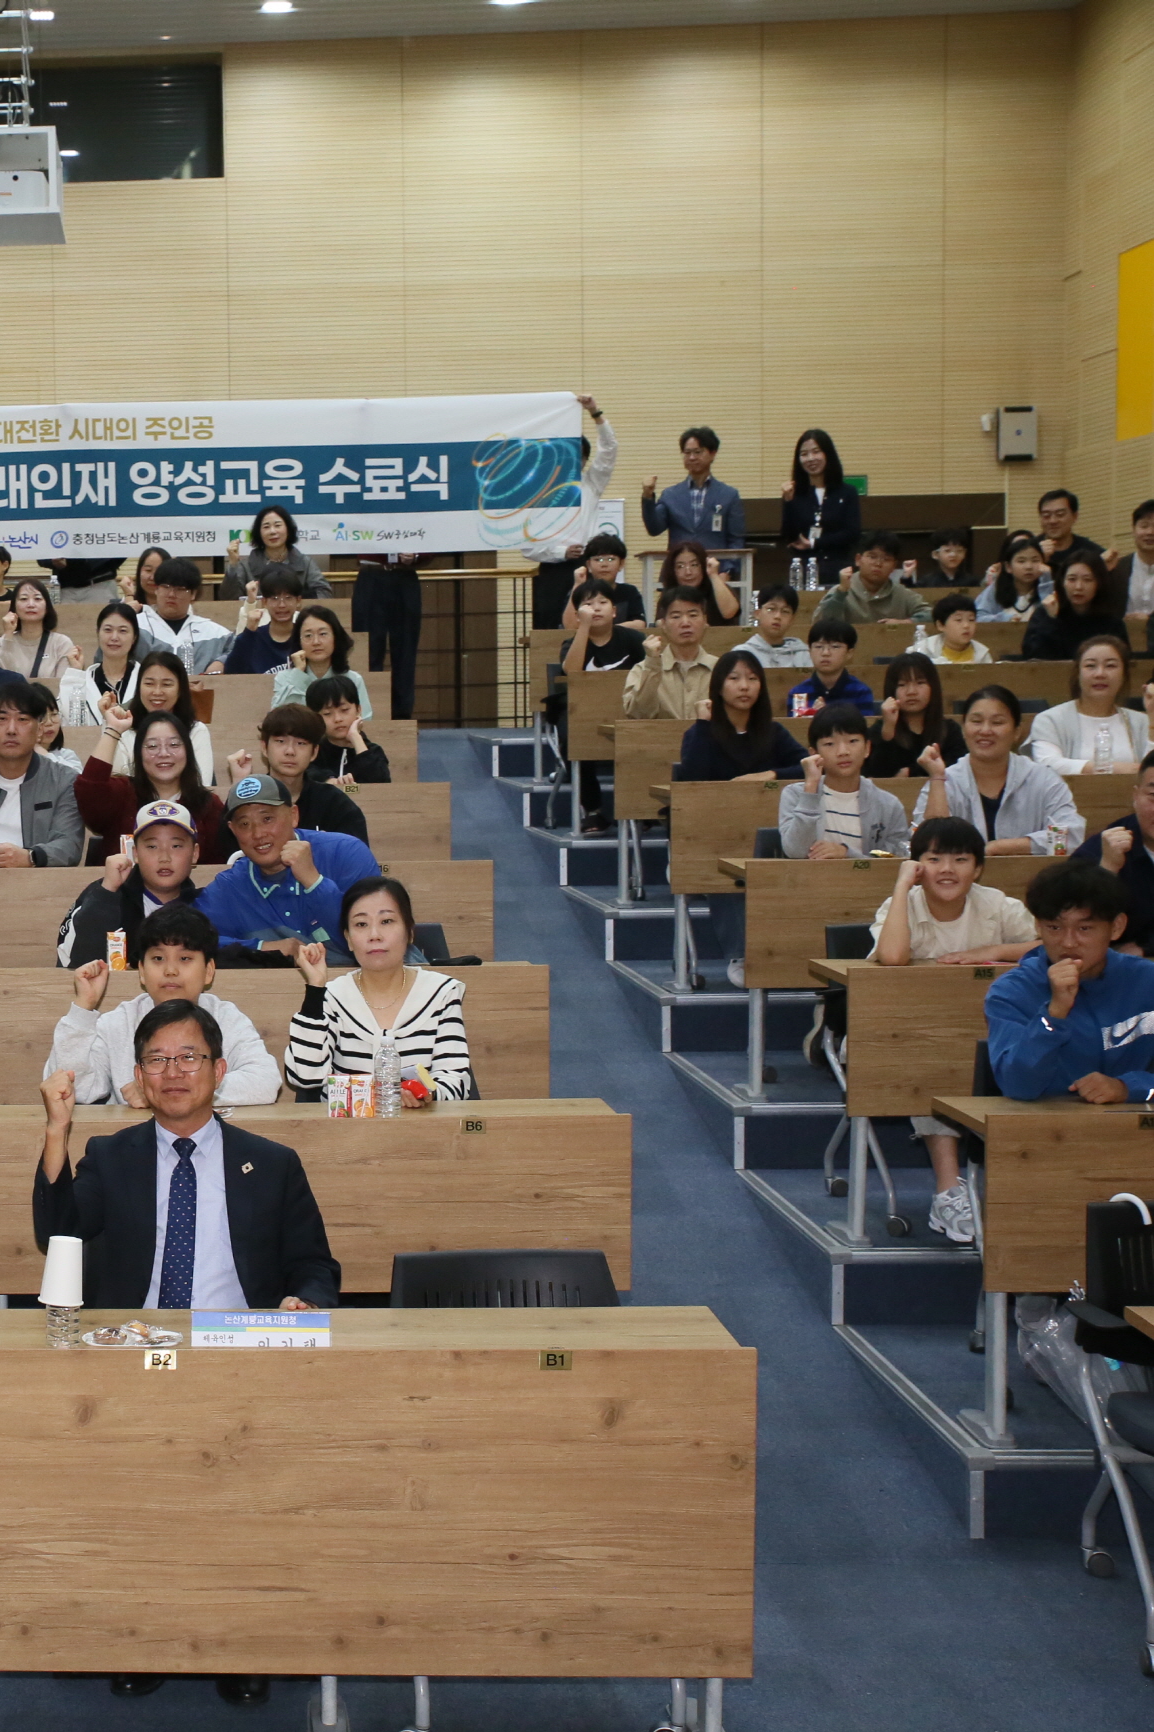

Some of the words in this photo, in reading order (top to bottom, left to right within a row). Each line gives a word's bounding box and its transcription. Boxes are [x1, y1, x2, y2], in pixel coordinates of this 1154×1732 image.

[68, 417, 137, 442] 시대의
[145, 415, 215, 440] 주인공
[129, 458, 305, 507] 양성교육
[318, 455, 449, 504] 수료식
[5, 531, 38, 549] 논산시
[345, 785, 359, 793] B21
[974, 968, 993, 978] A15
[465, 1120, 483, 1132] B6
[151, 1353, 172, 1366] B2
[546, 1354, 565, 1366] B1
